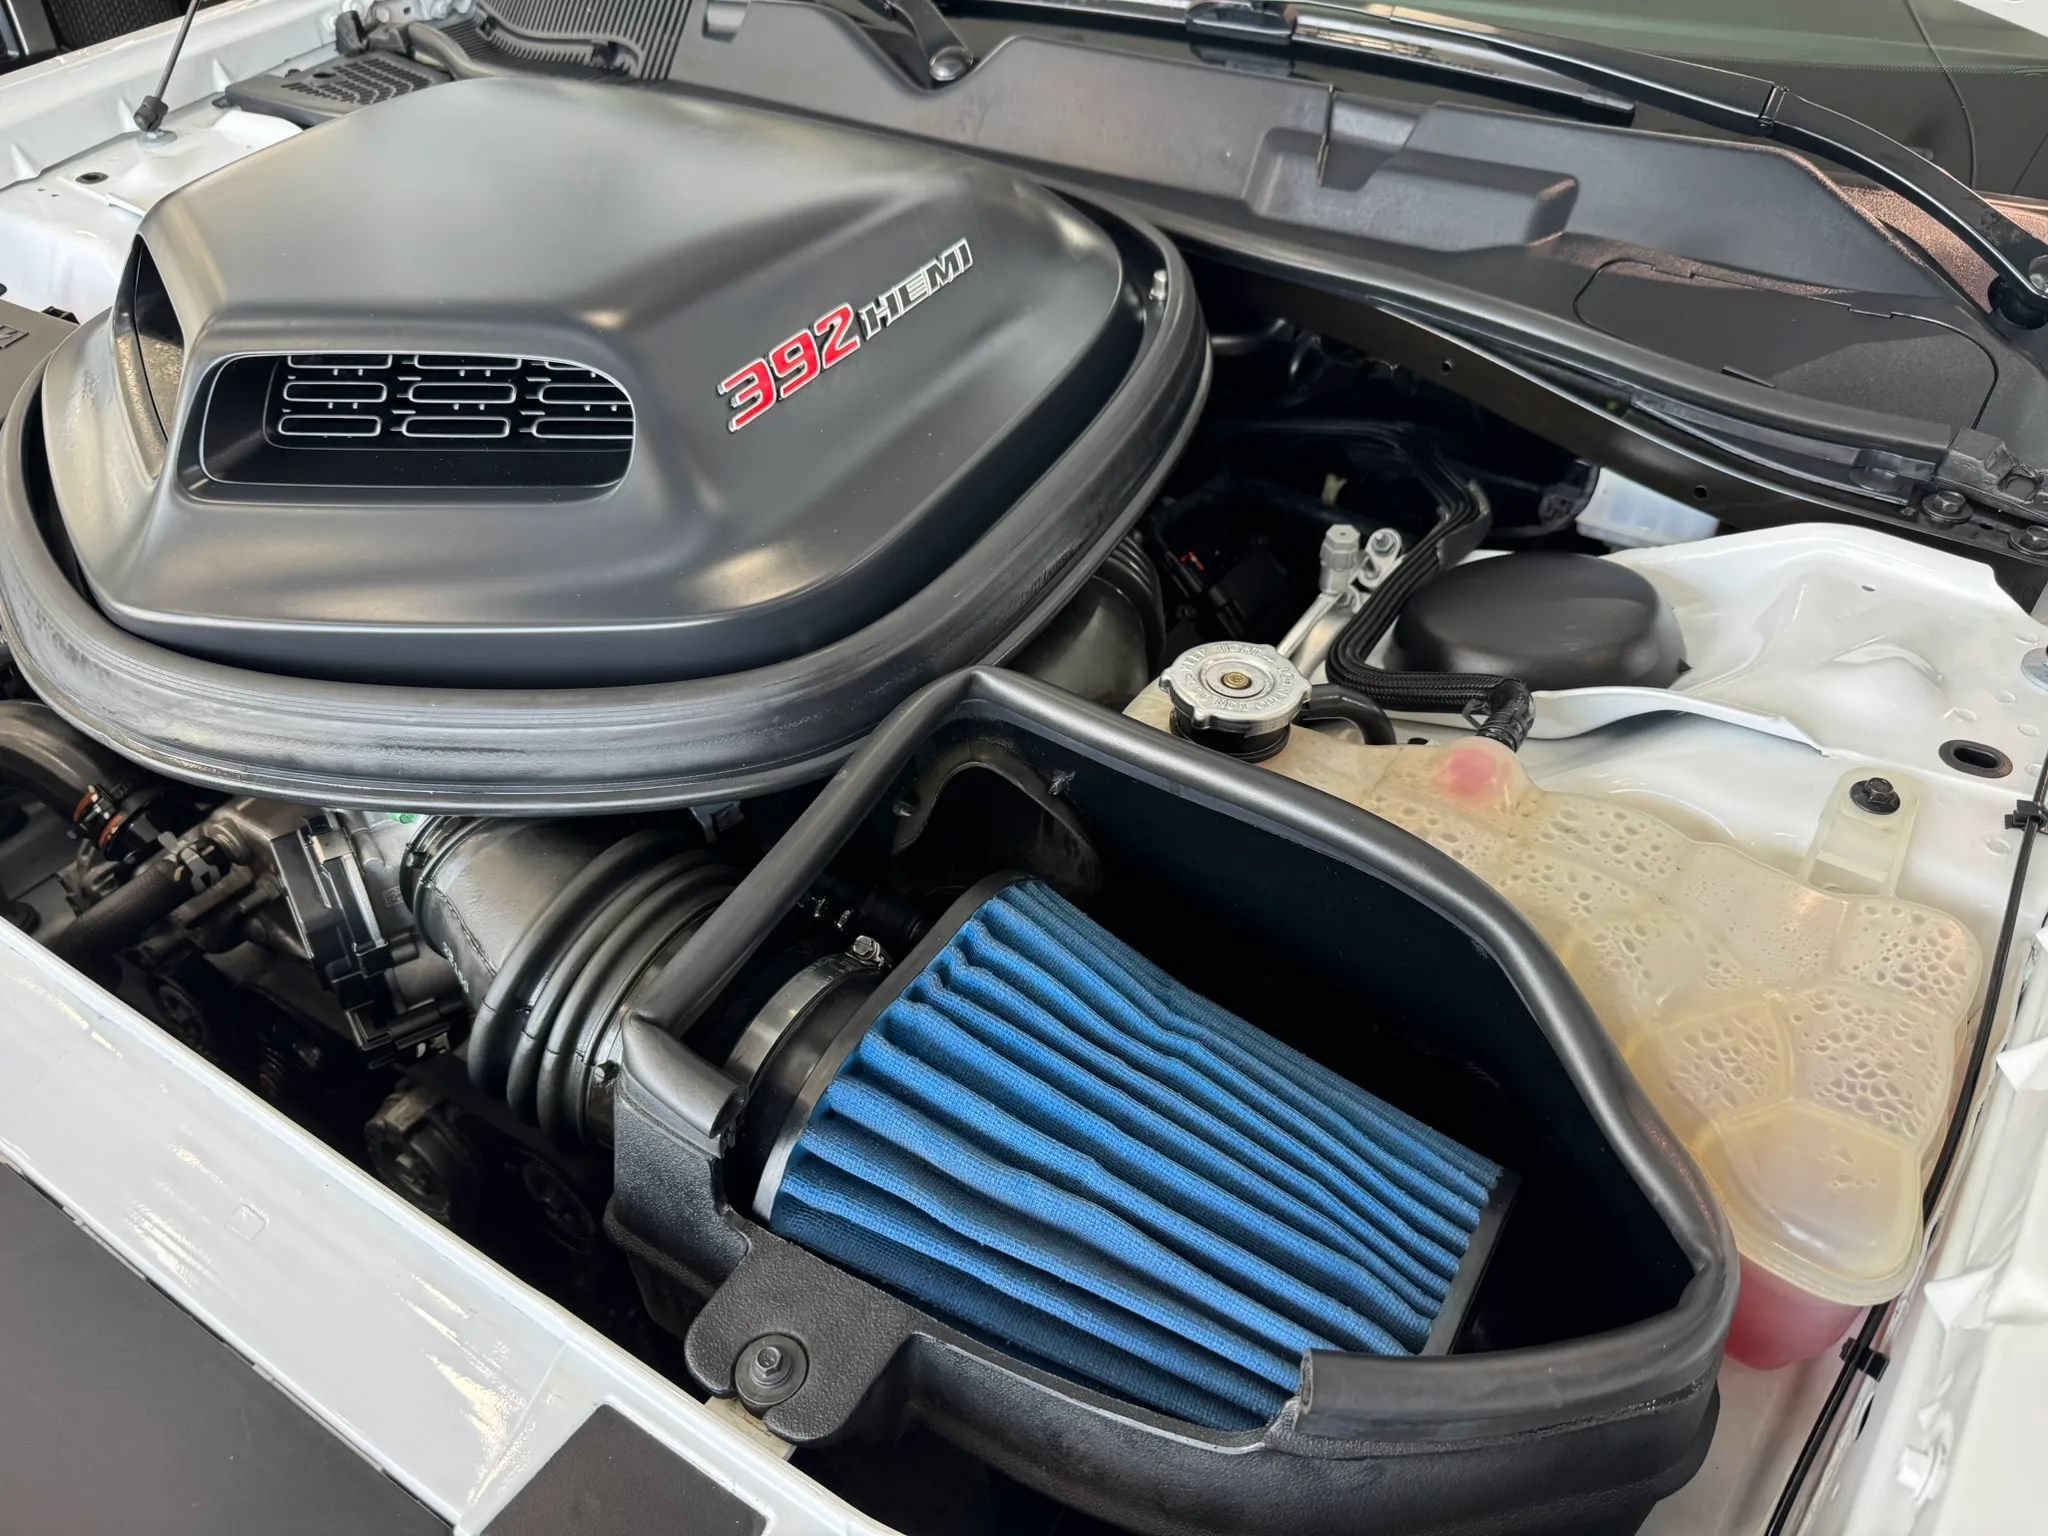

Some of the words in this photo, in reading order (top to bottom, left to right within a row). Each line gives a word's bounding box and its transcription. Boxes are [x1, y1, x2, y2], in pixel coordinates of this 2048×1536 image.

[718, 303, 861, 432] 392
[859, 238, 973, 341] HEMI
[1216, 644, 1262, 656] TIGHT
[1215, 698, 1247, 710] NOT
[1256, 689, 1288, 709] OPEN
